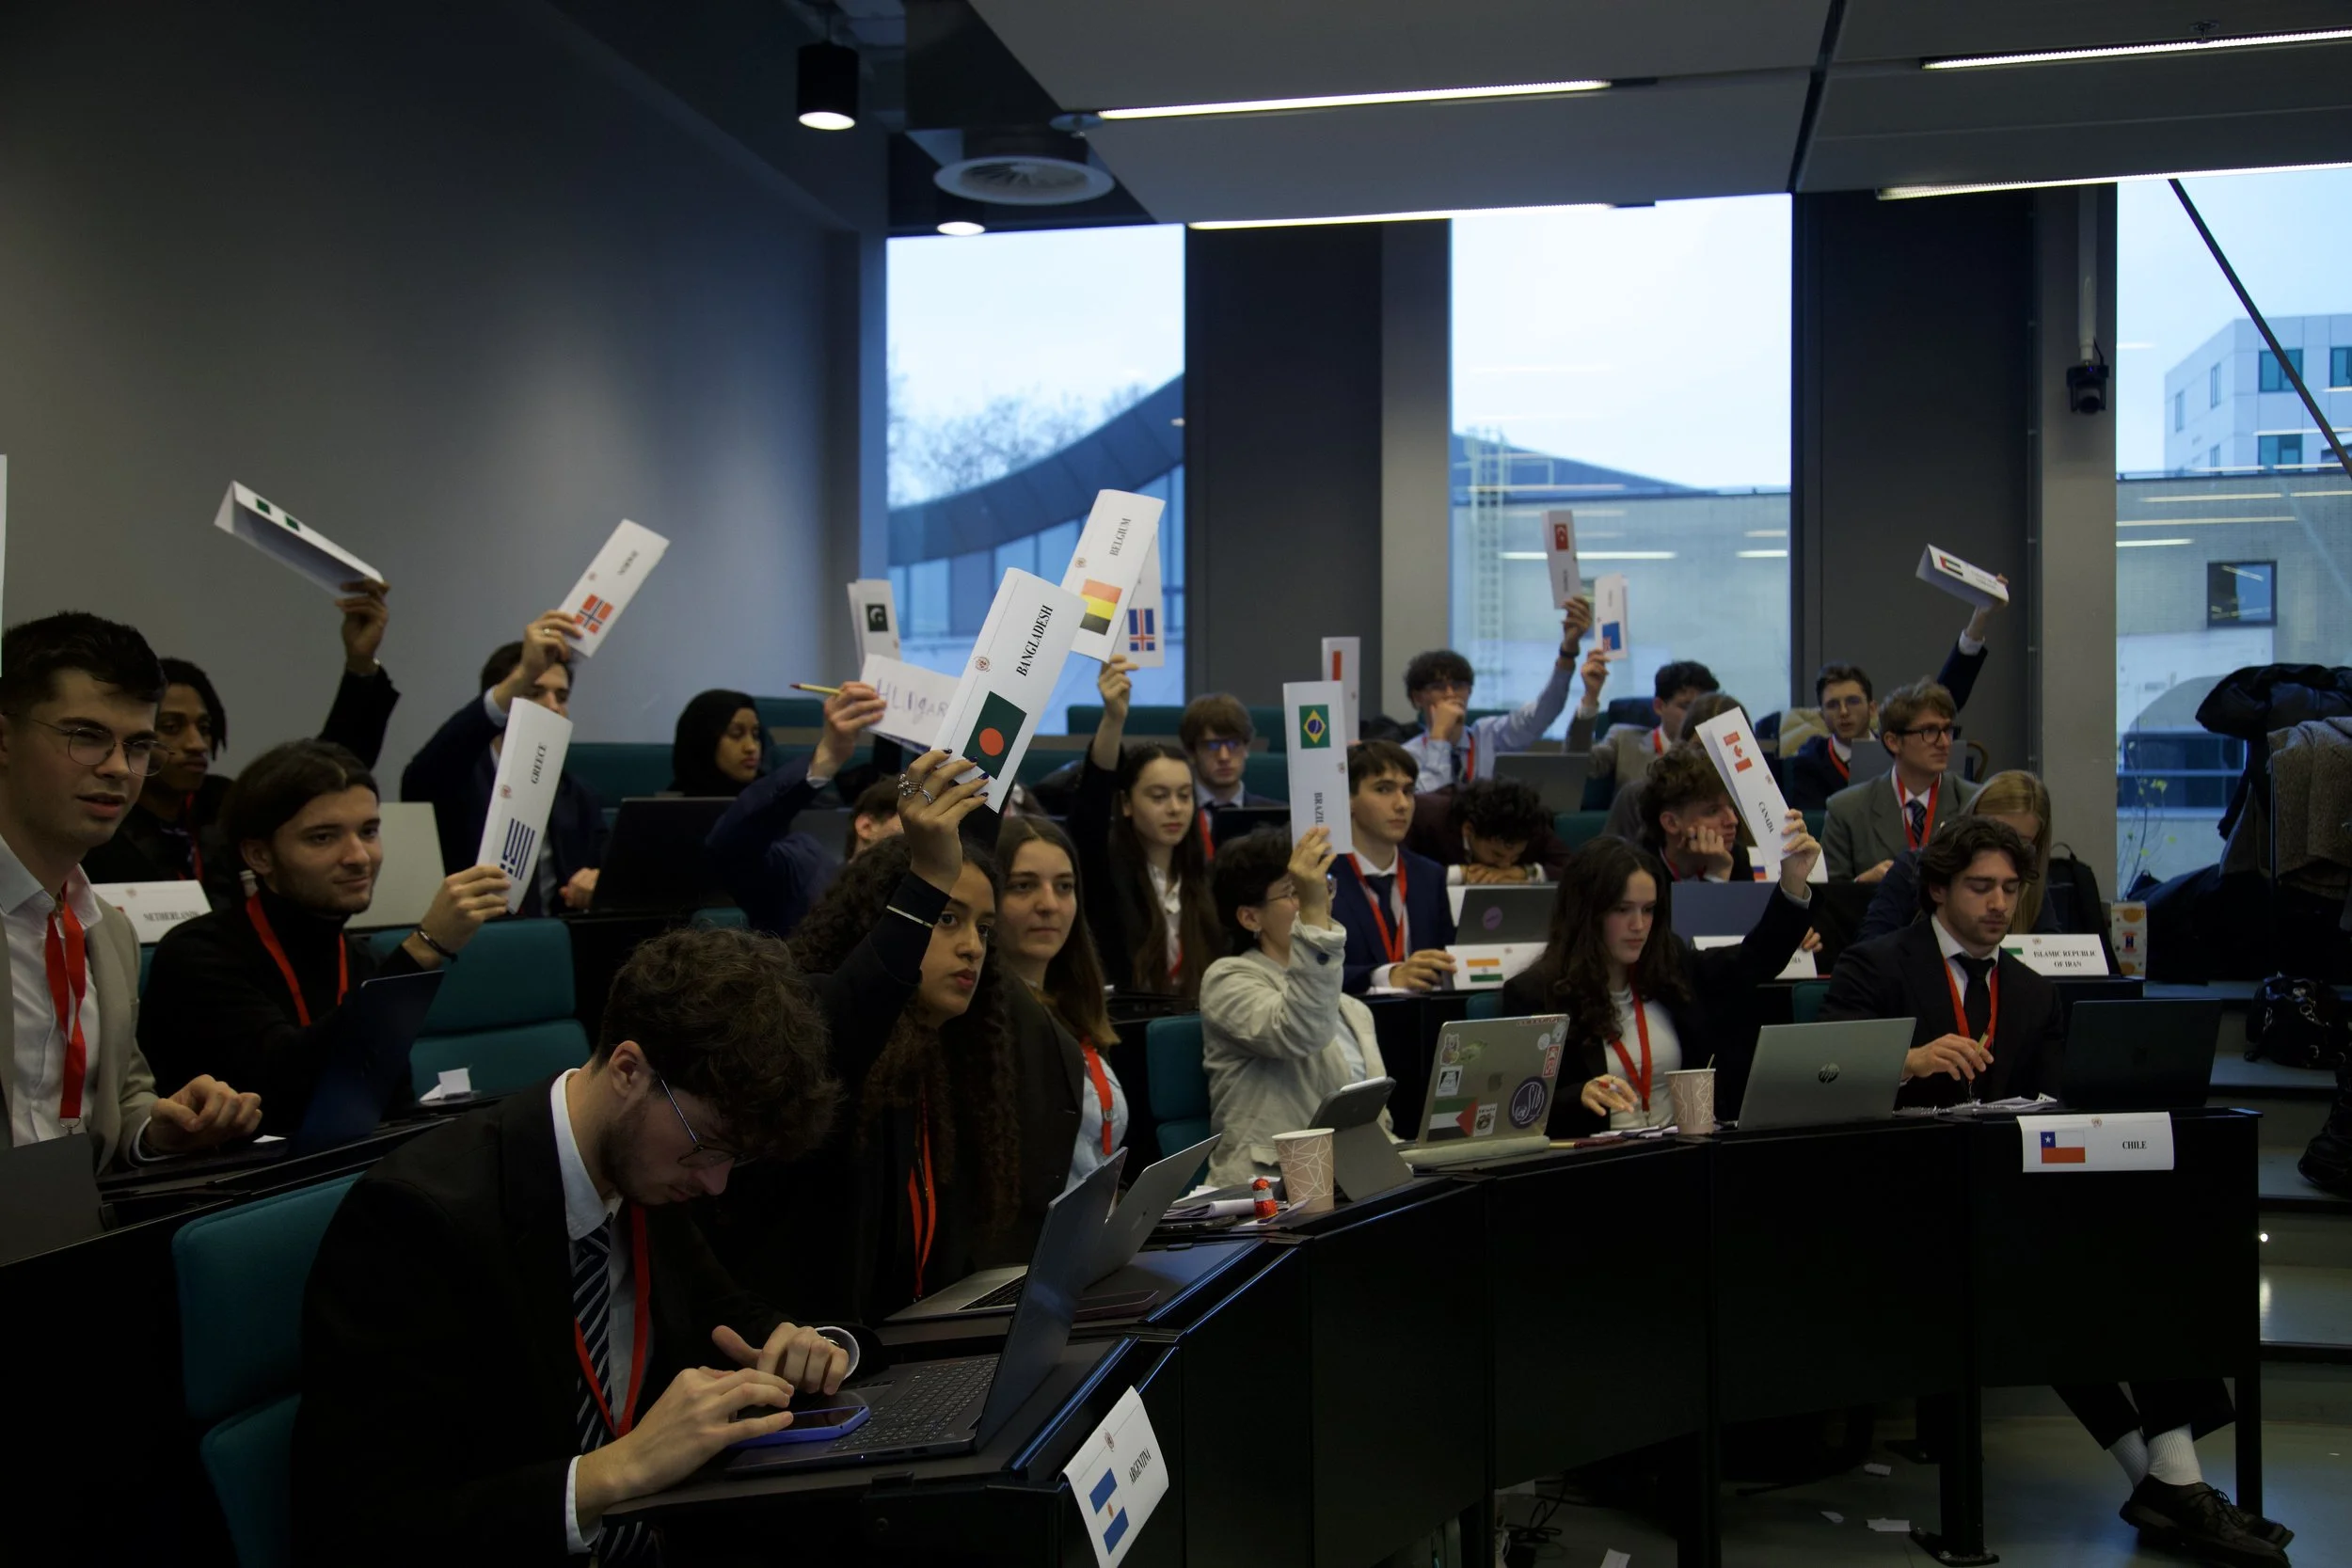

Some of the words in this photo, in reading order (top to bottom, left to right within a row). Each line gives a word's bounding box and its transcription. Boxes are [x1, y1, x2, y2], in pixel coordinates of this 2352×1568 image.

[1109, 517, 1132, 556] BELGIUM
[1016, 604, 1054, 676] BANGLADESH
[531, 743, 547, 784] GREECE
[1313, 792, 1324, 825] BRAZIL
[1757, 800, 1774, 834] CANADA
[2033, 950, 2059, 958] ISLAMIC
[2122, 1141, 2147, 1149] CHILE
[1129, 1447, 1152, 1485] ARGENTINA
